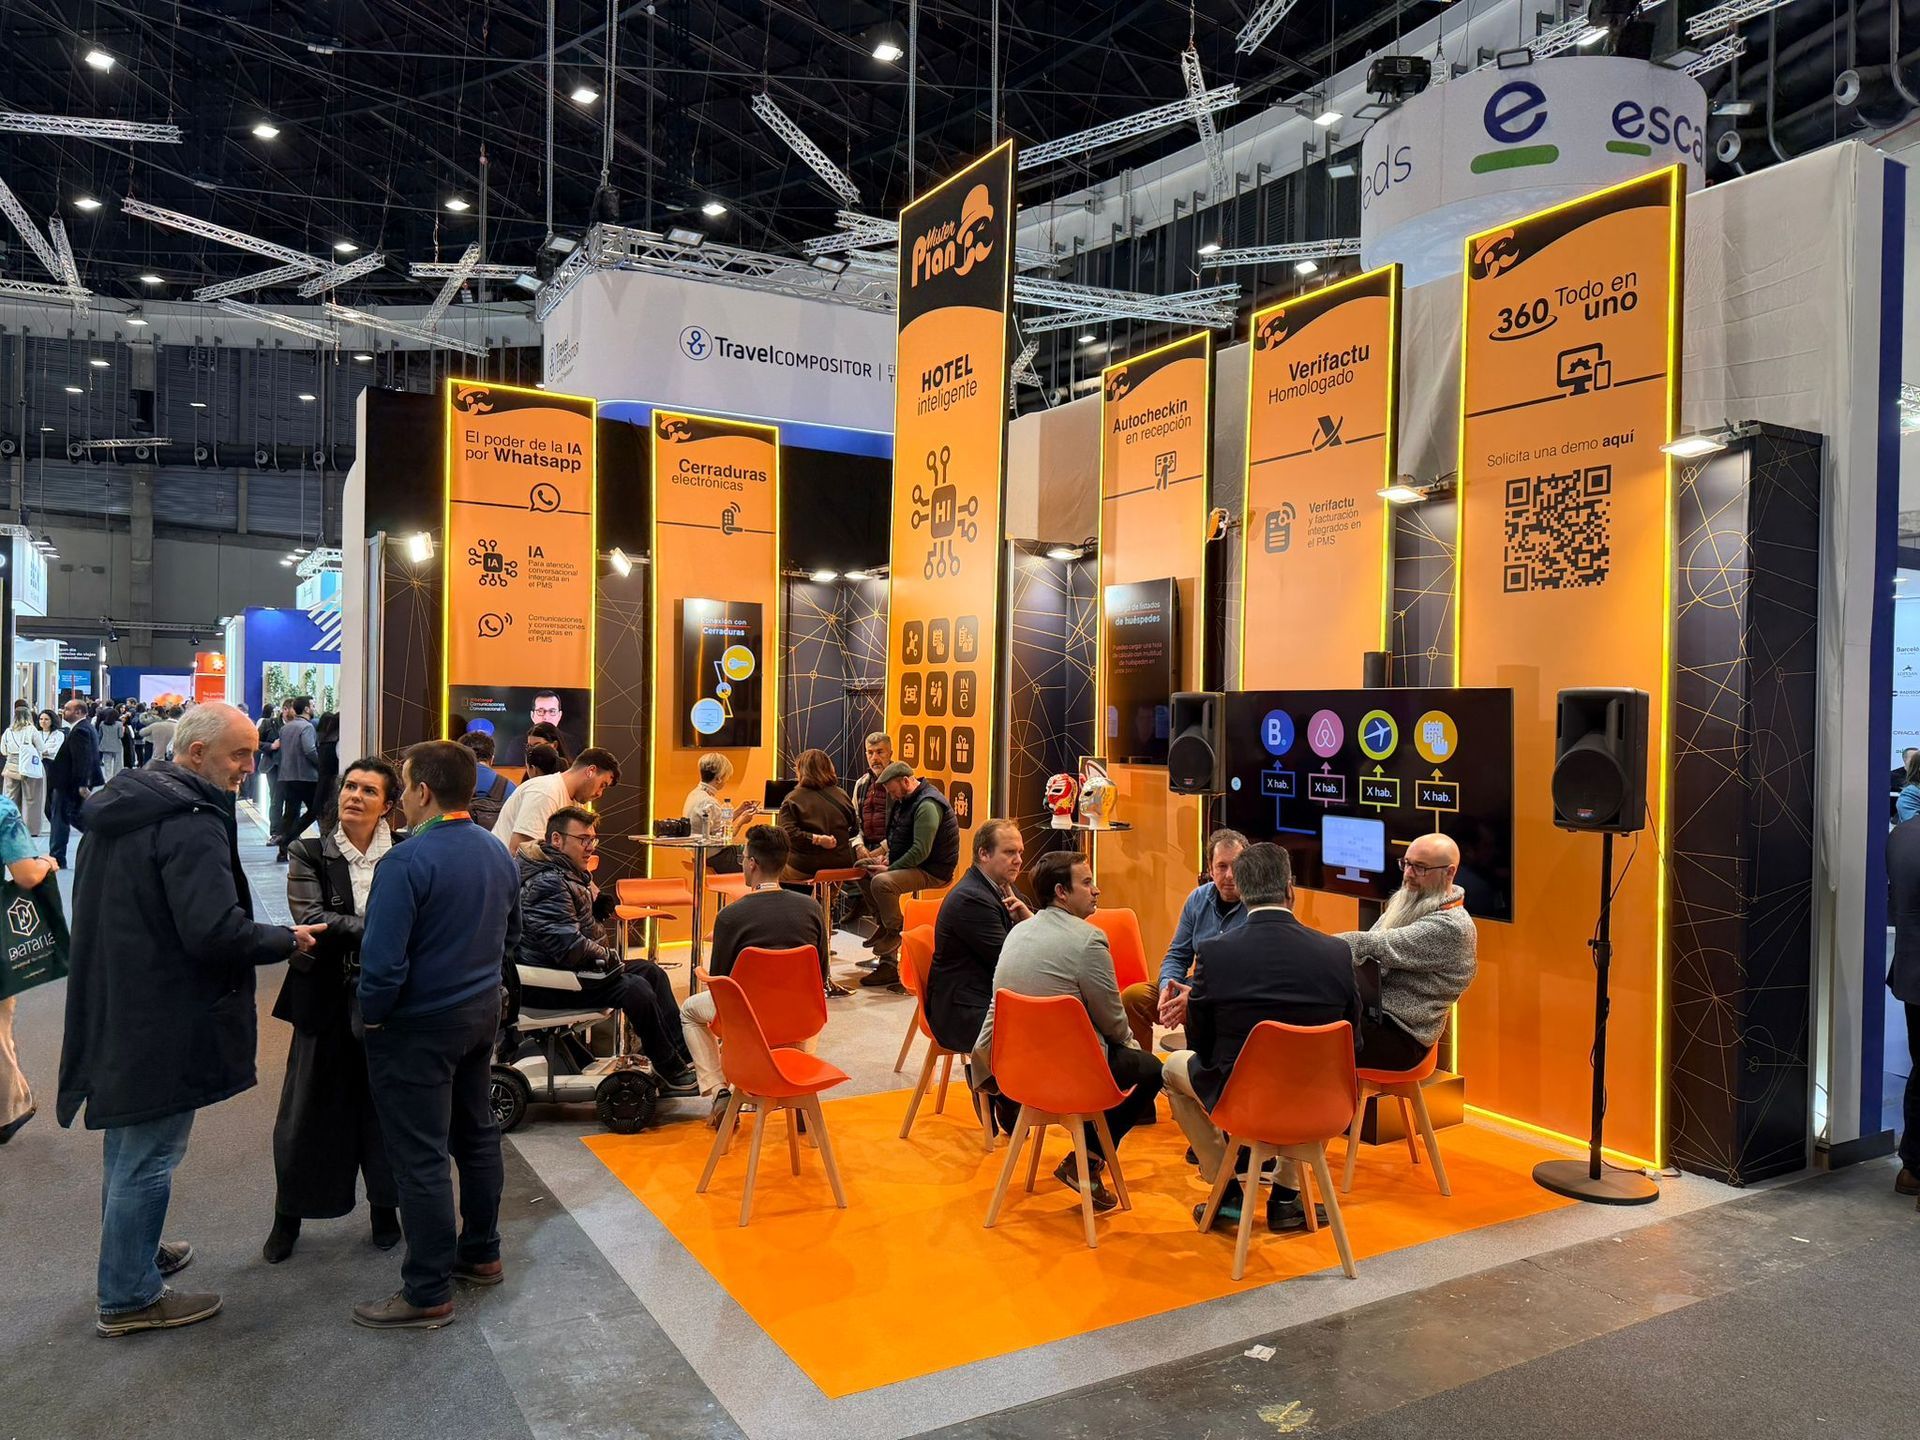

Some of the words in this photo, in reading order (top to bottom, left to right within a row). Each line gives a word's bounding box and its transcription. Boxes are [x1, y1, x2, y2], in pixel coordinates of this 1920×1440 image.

[1611, 100, 1703, 167] esca
[926, 220, 956, 251] Mister
[911, 235, 956, 288] Plan
[1555, 280, 1604, 307] Todo
[1611, 272, 1637, 292] en
[1584, 291, 1638, 321] uno
[1497, 297, 1549, 334] 360
[1288, 344, 1370, 382] Verifactu
[921, 353, 974, 394] HOTEL
[1268, 368, 1354, 405] Homologado
[917, 378, 978, 416] inteligente
[1112, 398, 1188, 434] Autocheckin
[1125, 432, 1138, 445] en
[1141, 414, 1192, 441] recepción
[465, 430, 480, 443] El
[484, 435, 525, 448] poder
[529, 438, 547, 451] de
[551, 440, 563, 453] la
[567, 442, 583, 456] IA
[1487, 452, 1530, 468] Solicita
[1533, 446, 1557, 460] una
[1561, 439, 1599, 455] demo
[1602, 429, 1635, 449] aquí
[465, 448, 489, 461] por
[493, 447, 581, 473] Whatsapp
[678, 458, 767, 482] Cerraduras
[671, 473, 744, 491] electrónicas
[1309, 497, 1355, 514] Verifactu
[1308, 518, 1313, 528] y
[1314, 508, 1359, 524] facturación
[1307, 523, 1349, 536] integrados
[1350, 521, 1362, 530] en
[1307, 538, 1315, 548] el
[1316, 535, 1336, 546] PMS
[528, 545, 545, 559] IA
[487, 558, 499, 568] IA
[528, 568, 579, 576] conversacional
[545, 561, 575, 569] atención
[528, 574, 560, 582] integrada
[528, 614, 583, 623] Comunicaciones
[533, 623, 586, 631] conversaciones
[1115, 617, 1123, 626] de
[528, 629, 563, 637] integradas
[703, 627, 745, 636] Cerraduras
[1267, 779, 1273, 787] X
[1273, 779, 1290, 790] hab.
[1315, 783, 1322, 792] X
[1322, 783, 1338, 793] hab.
[1366, 787, 1374, 796] X
[1374, 787, 1392, 798] hab.
[1423, 791, 1431, 801] X
[1431, 791, 1451, 802] hab.
